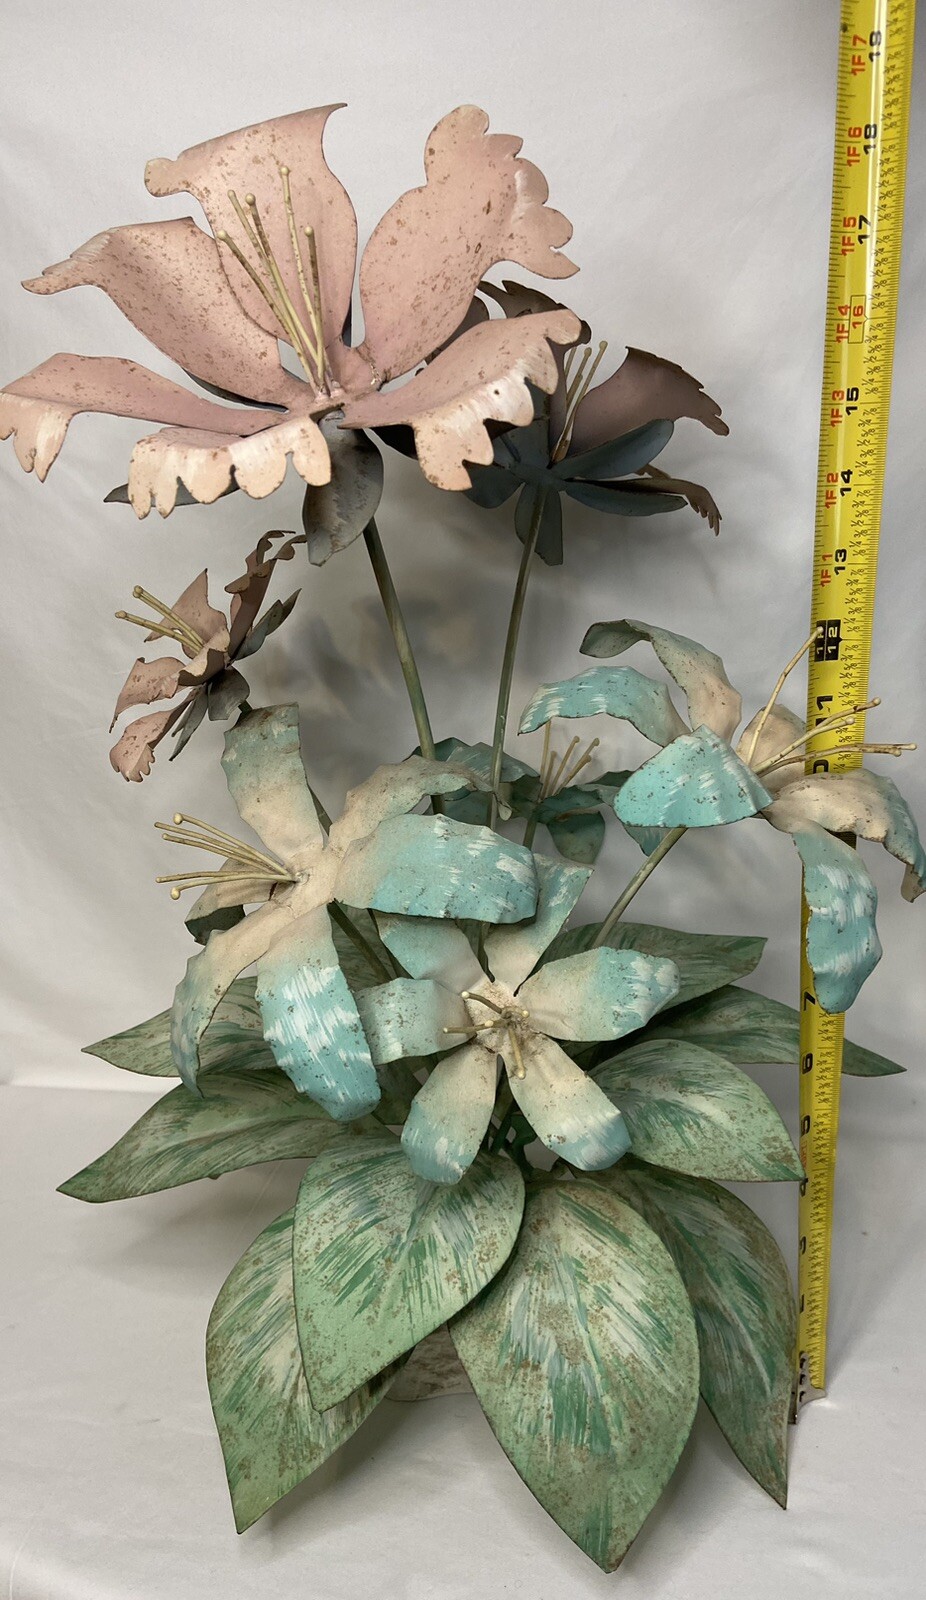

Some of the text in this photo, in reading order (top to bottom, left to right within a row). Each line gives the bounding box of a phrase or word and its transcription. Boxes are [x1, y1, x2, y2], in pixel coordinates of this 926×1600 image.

[863, 123, 878, 156] 18
[857, 215, 872, 245] 17
[851, 305, 864, 329] 16
[845, 387, 860, 416] 15
[840, 469, 853, 498] 14
[834, 548, 848, 576] 13
[827, 626, 838, 654] 12
[803, 991, 816, 1011] 7
